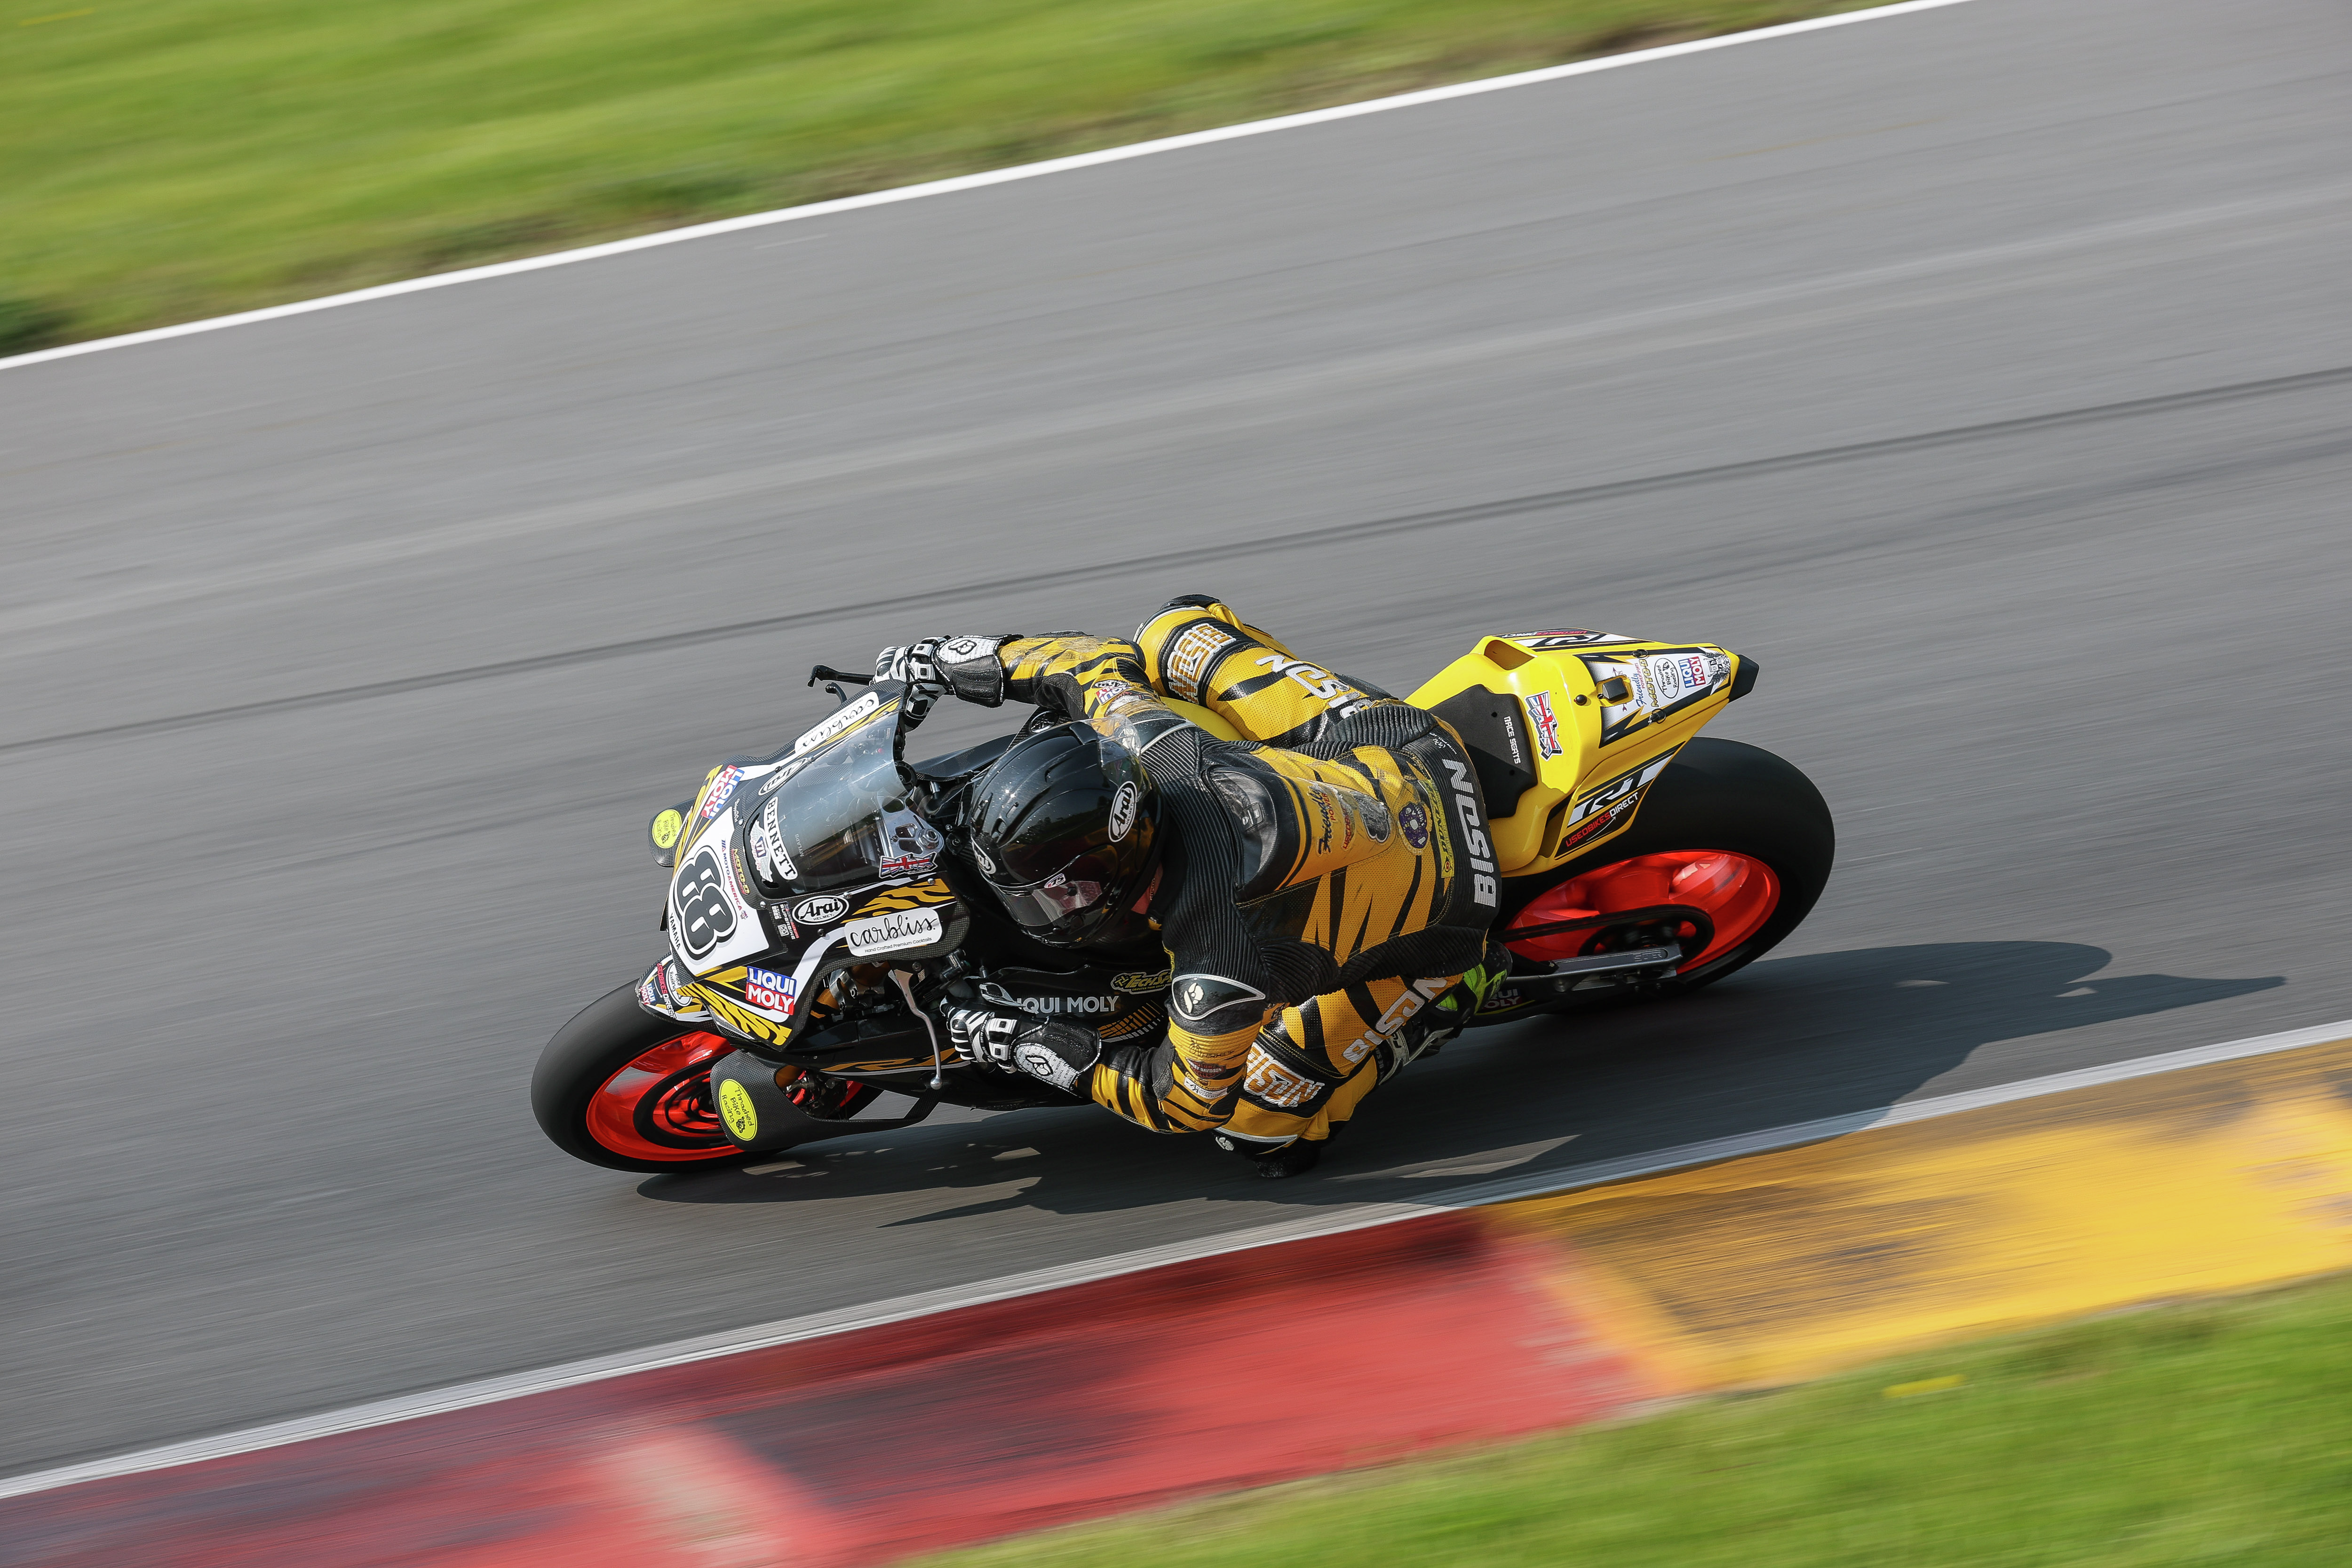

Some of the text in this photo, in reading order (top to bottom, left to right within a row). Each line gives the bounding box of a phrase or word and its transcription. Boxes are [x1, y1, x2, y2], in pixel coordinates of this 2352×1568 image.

[1656, 665, 1667, 693] Thrashed
[1680, 660, 1694, 688] LIQUI
[1690, 658, 1705, 684] MOLY
[1631, 673, 1647, 707] Friendly
[1504, 716, 1521, 764] RACE SEATS
[703, 766, 736, 817] MOLY
[709, 768, 744, 819] LIQUI
[1113, 788, 1132, 838] Arai
[1565, 792, 1639, 847] USEDBIKESDIRECT
[767, 799, 796, 877] BENNETT
[794, 834, 804, 857] MYLAPS
[1442, 758, 1496, 907] BISON
[723, 852, 742, 911] MOTOAMERICA
[733, 848, 750, 894] MOTO-D
[675, 848, 735, 956] 88
[799, 898, 841, 920] Arai
[669, 913, 681, 950] YAMAHA
[780, 904, 796, 940] SUPERBIKE
[913, 937, 932, 945] Cocktails
[640, 986, 651, 1005] MOLY
[646, 983, 656, 1003] LIQUI
[748, 967, 795, 996] LIQUI
[747, 984, 794, 1013] MOLY
[1017, 996, 1120, 1014] IQUI MOLY
[1484, 996, 1520, 1009] OLY
[721, 1094, 735, 1124] Racing
[730, 1097, 741, 1115] Bike
[734, 1087, 754, 1127] Thrashed
